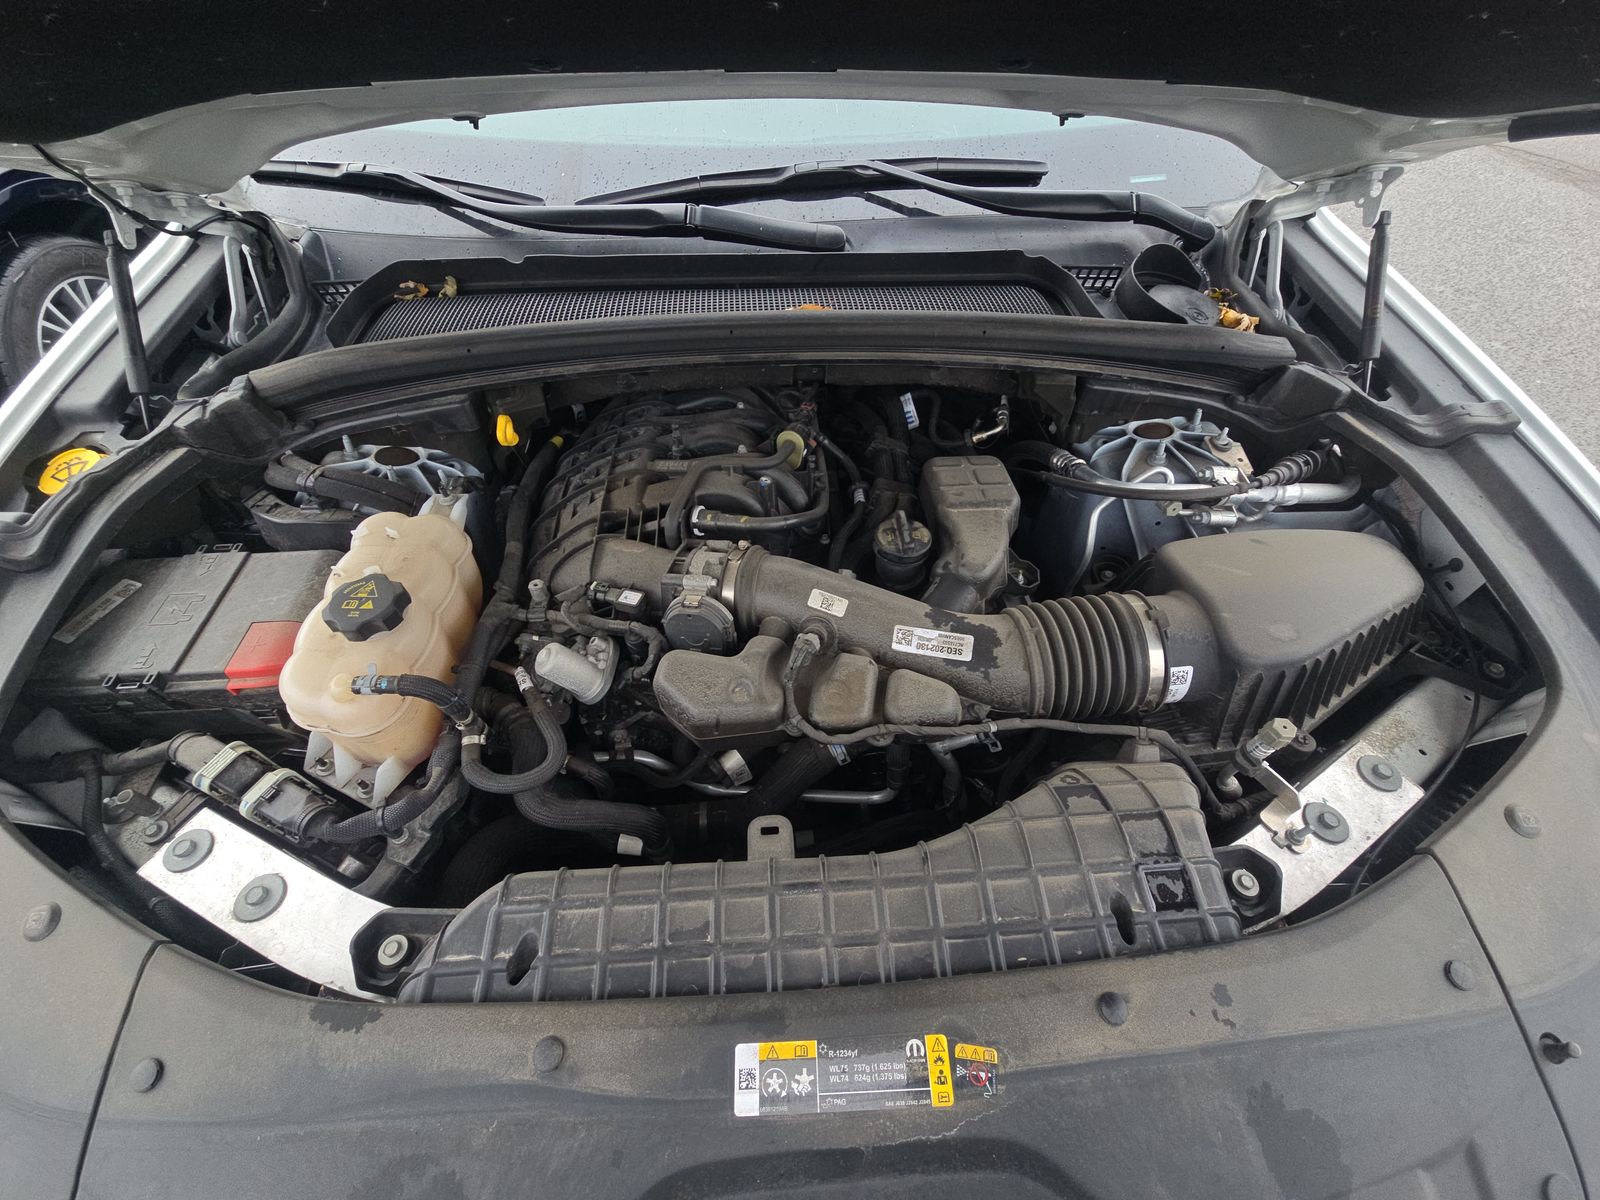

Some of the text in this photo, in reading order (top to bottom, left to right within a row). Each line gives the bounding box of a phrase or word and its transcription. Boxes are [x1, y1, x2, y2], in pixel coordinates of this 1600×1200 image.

[828, 1049, 858, 1058] R-1234yf
[829, 1065, 849, 1073] WL75
[853, 1064, 870, 1072] 737g
[871, 1063, 892, 1072] (1.625
[829, 1073, 907, 1083] WL74 624g (1.375 lbs)
[834, 1098, 846, 1106] PAG
